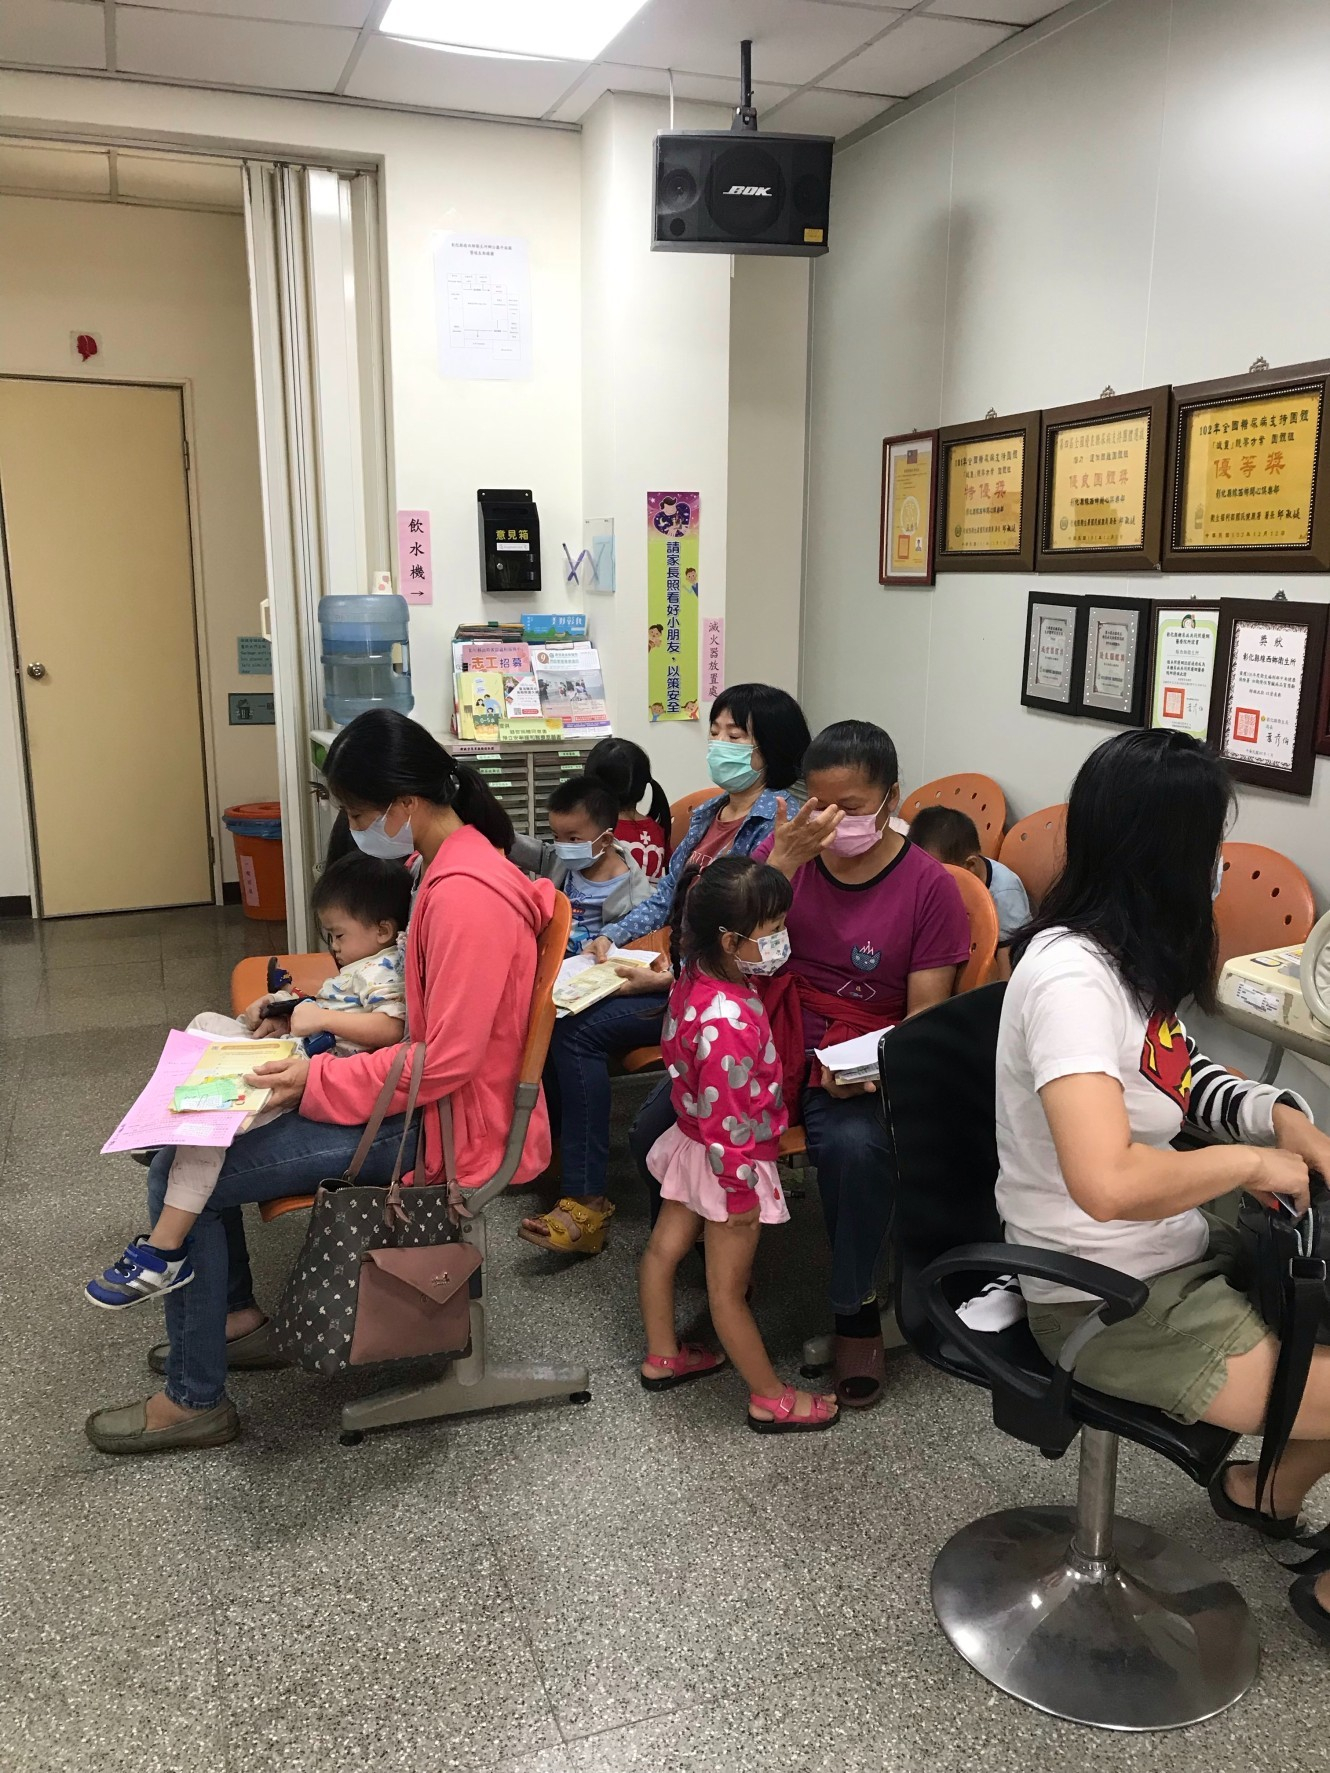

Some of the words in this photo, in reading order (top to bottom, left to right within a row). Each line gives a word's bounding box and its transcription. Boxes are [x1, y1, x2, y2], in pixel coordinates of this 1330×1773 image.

[722, 185, 773, 197] BOK
[1213, 451, 1286, 480] 優等獎
[495, 529, 530, 541] 意見箱
[408, 518, 426, 580] 飲水機
[666, 541, 681, 713] 請家長照看好小朋友，以策安全
[471, 656, 523, 670] 志工招募
[708, 621, 720, 698] 滅火器放置處
[1243, 652, 1297, 667] 彰化縣線西鄉衛生所
